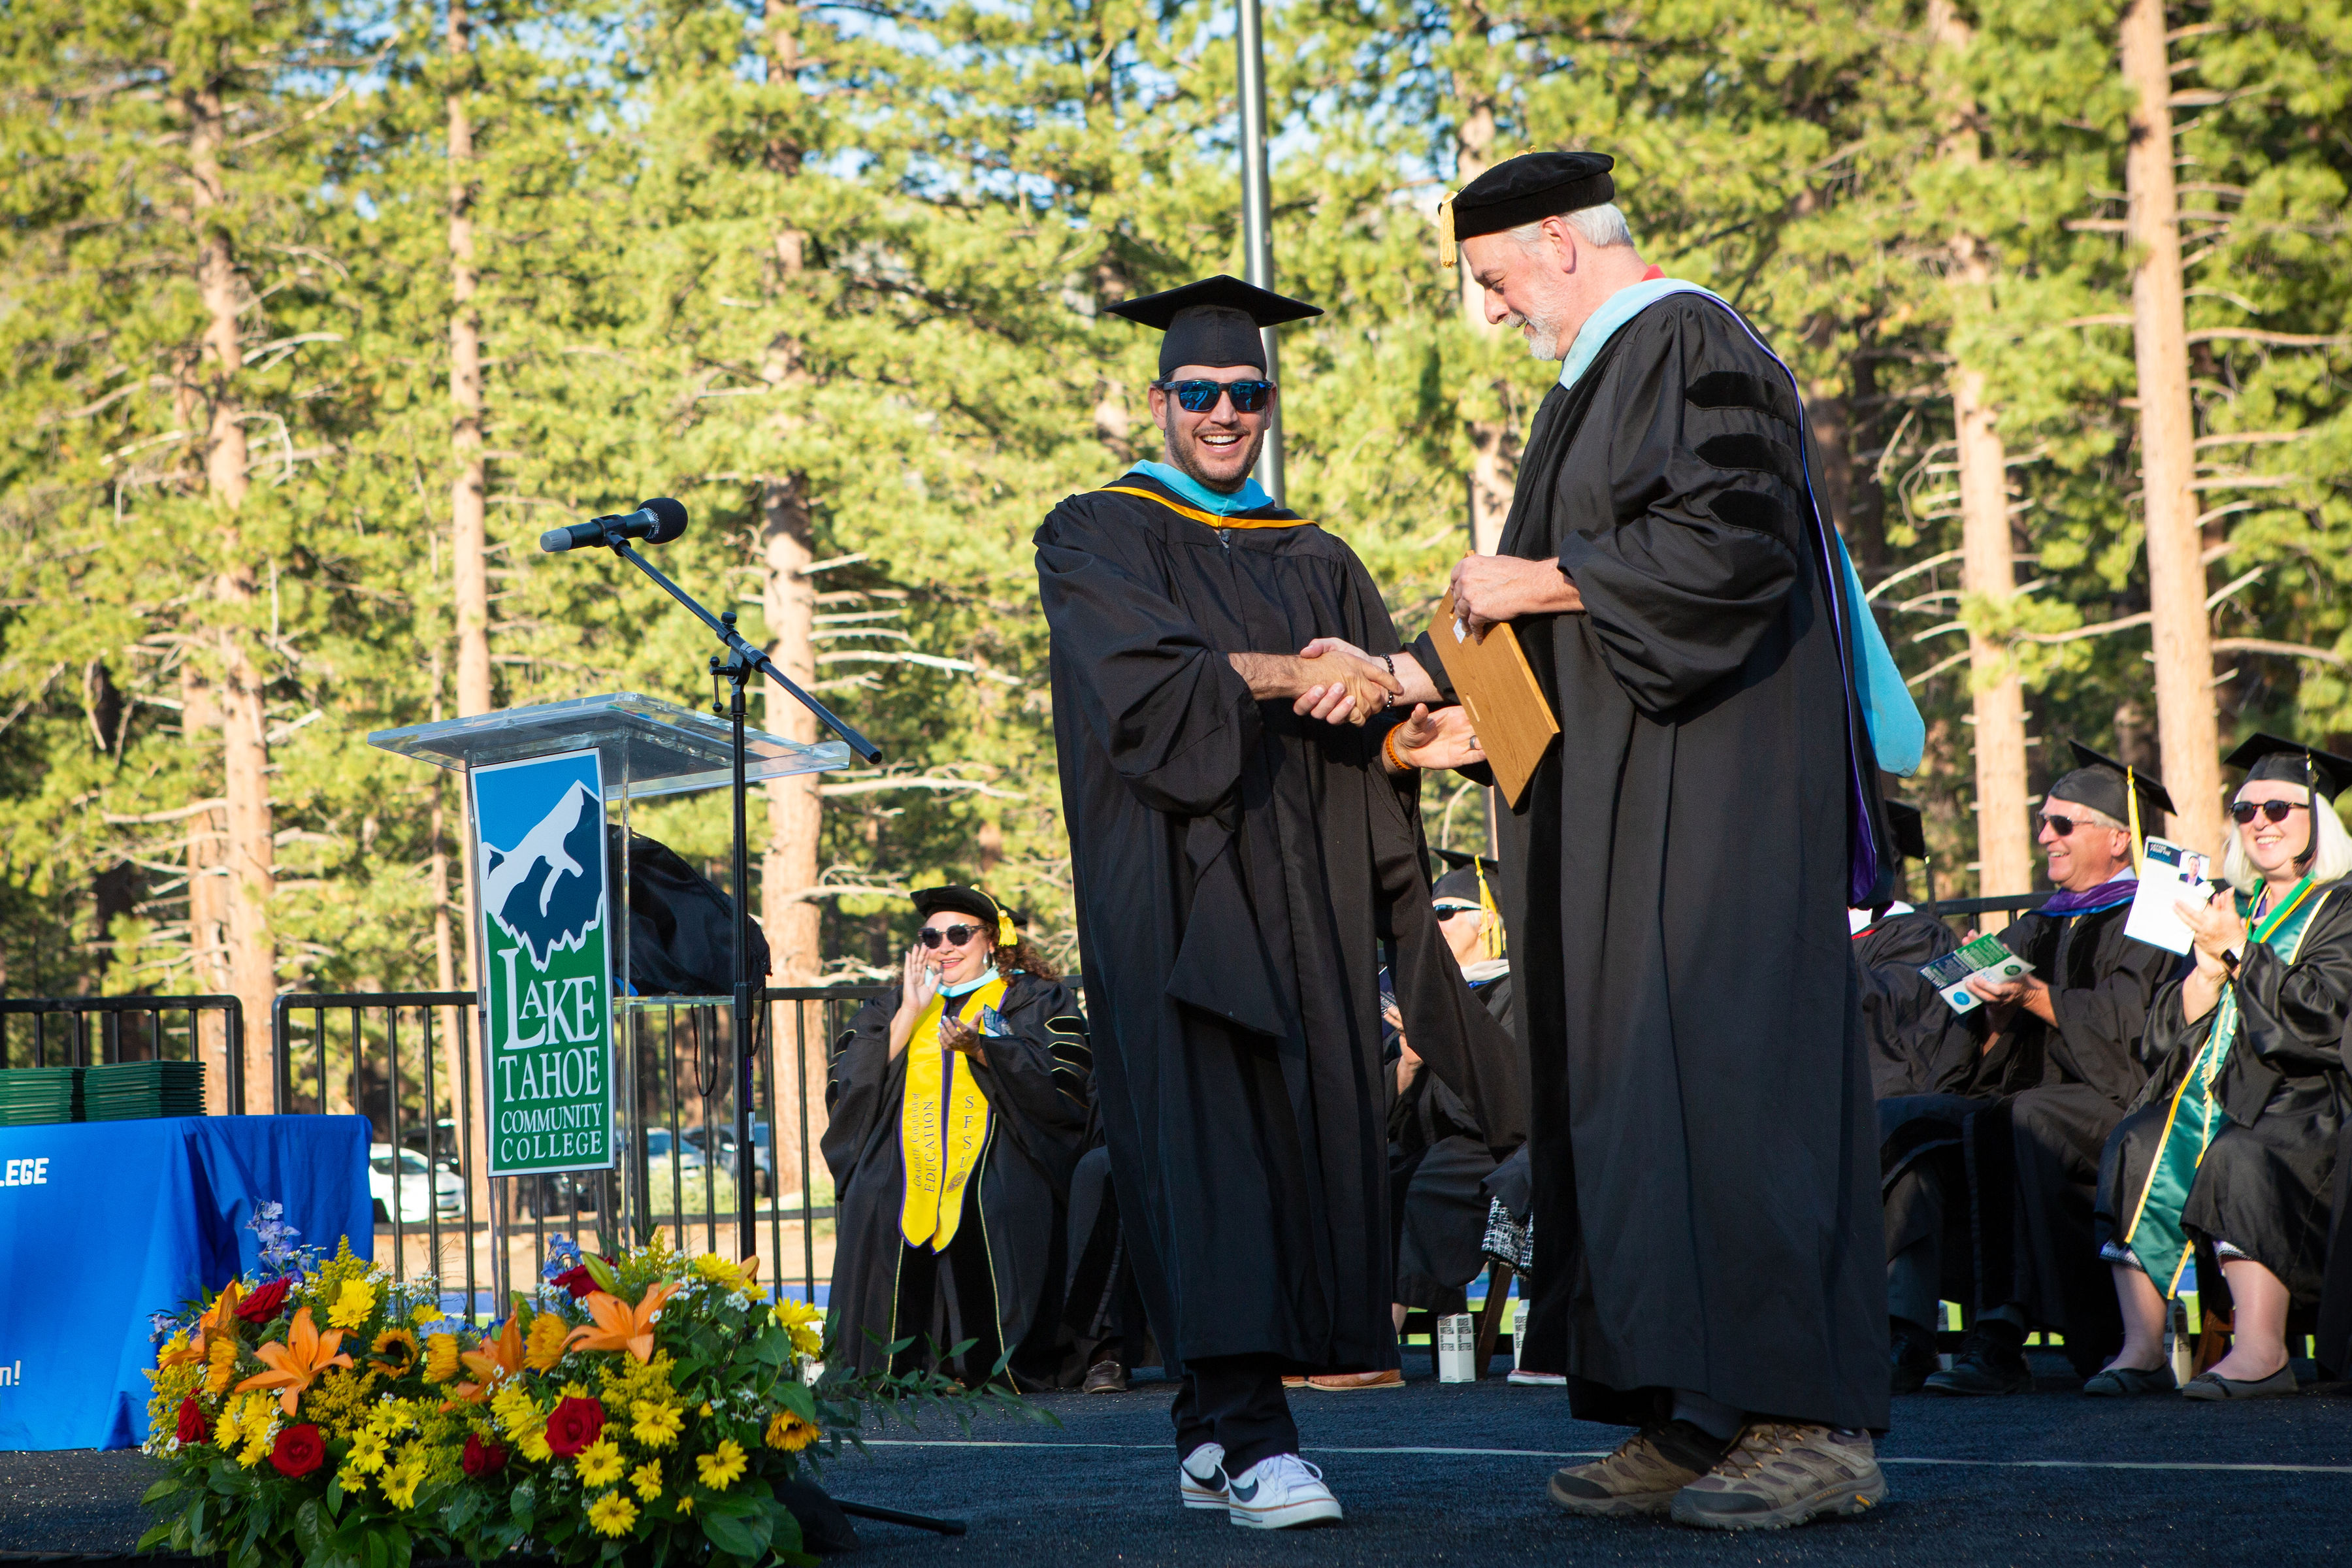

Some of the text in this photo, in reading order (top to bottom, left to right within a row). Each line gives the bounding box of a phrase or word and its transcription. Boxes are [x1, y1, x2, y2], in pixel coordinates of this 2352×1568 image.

[497, 947, 600, 1050] LAKE
[498, 1046, 600, 1102] TAHOE
[501, 1103, 602, 1134] COMMUNITY
[501, 1130, 602, 1163] COLLEGE
[923, 1102, 937, 1192] EDUCATION
